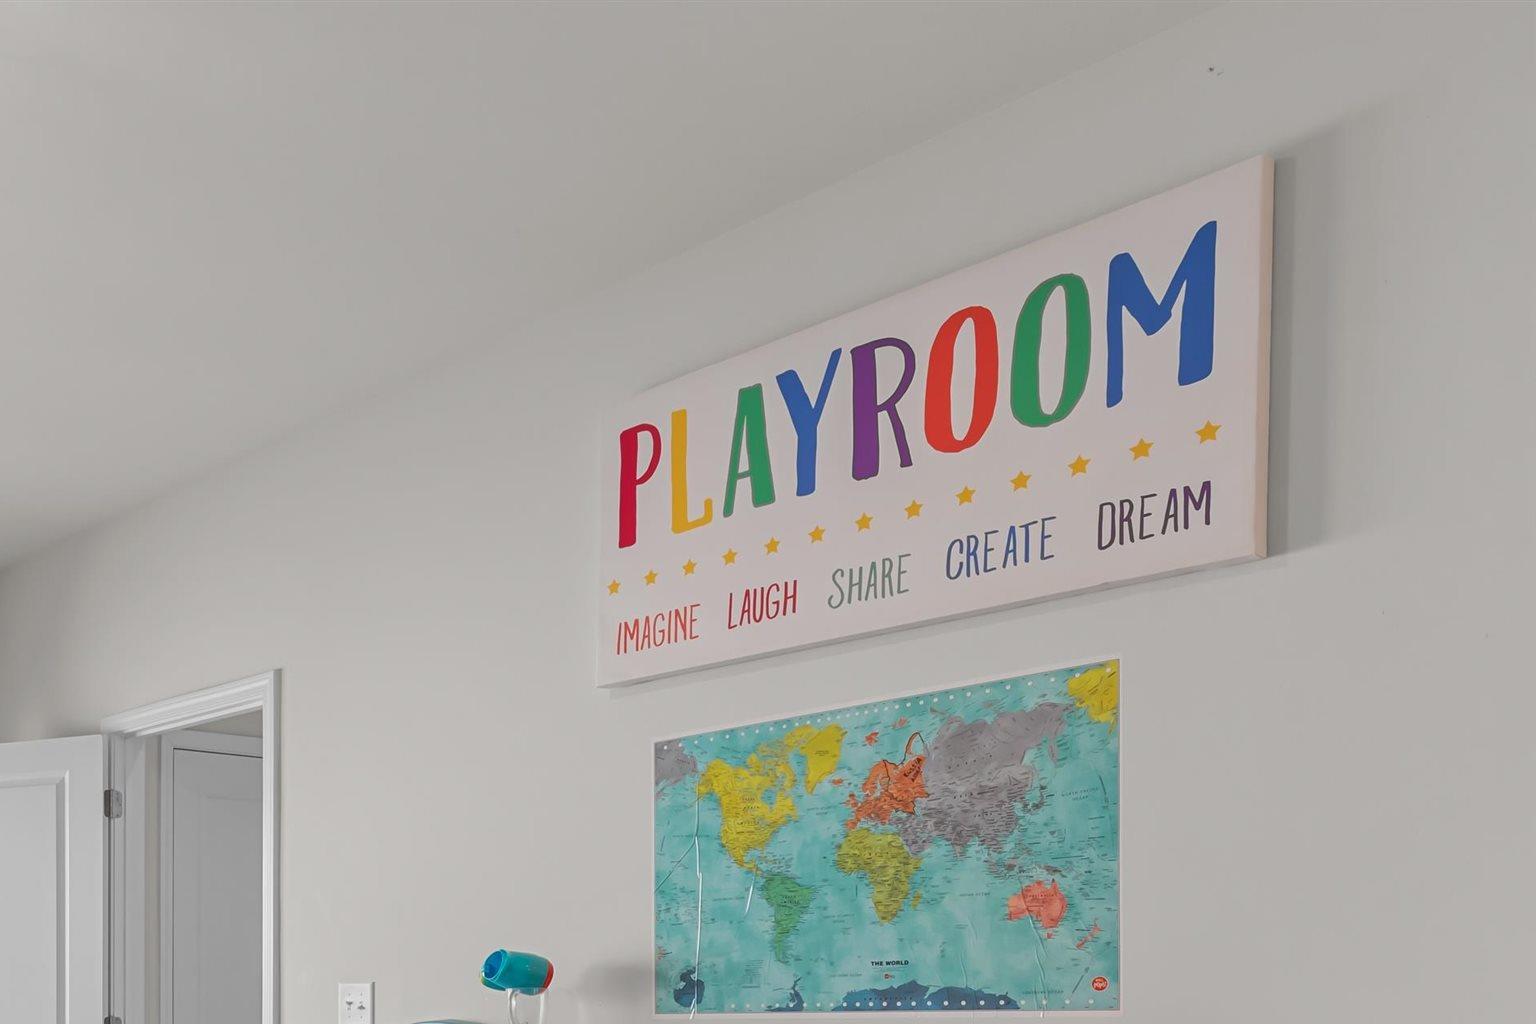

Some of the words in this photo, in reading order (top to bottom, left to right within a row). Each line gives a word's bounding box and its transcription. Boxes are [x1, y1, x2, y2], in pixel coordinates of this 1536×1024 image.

[618, 220, 1217, 549] PLAYROOM
[616, 603, 701, 656] IMAGINE
[727, 579, 798, 630] LAUGH
[827, 553, 912, 610] SHARE
[945, 515, 1057, 581] CREATE
[1097, 479, 1212, 551] DREAM
